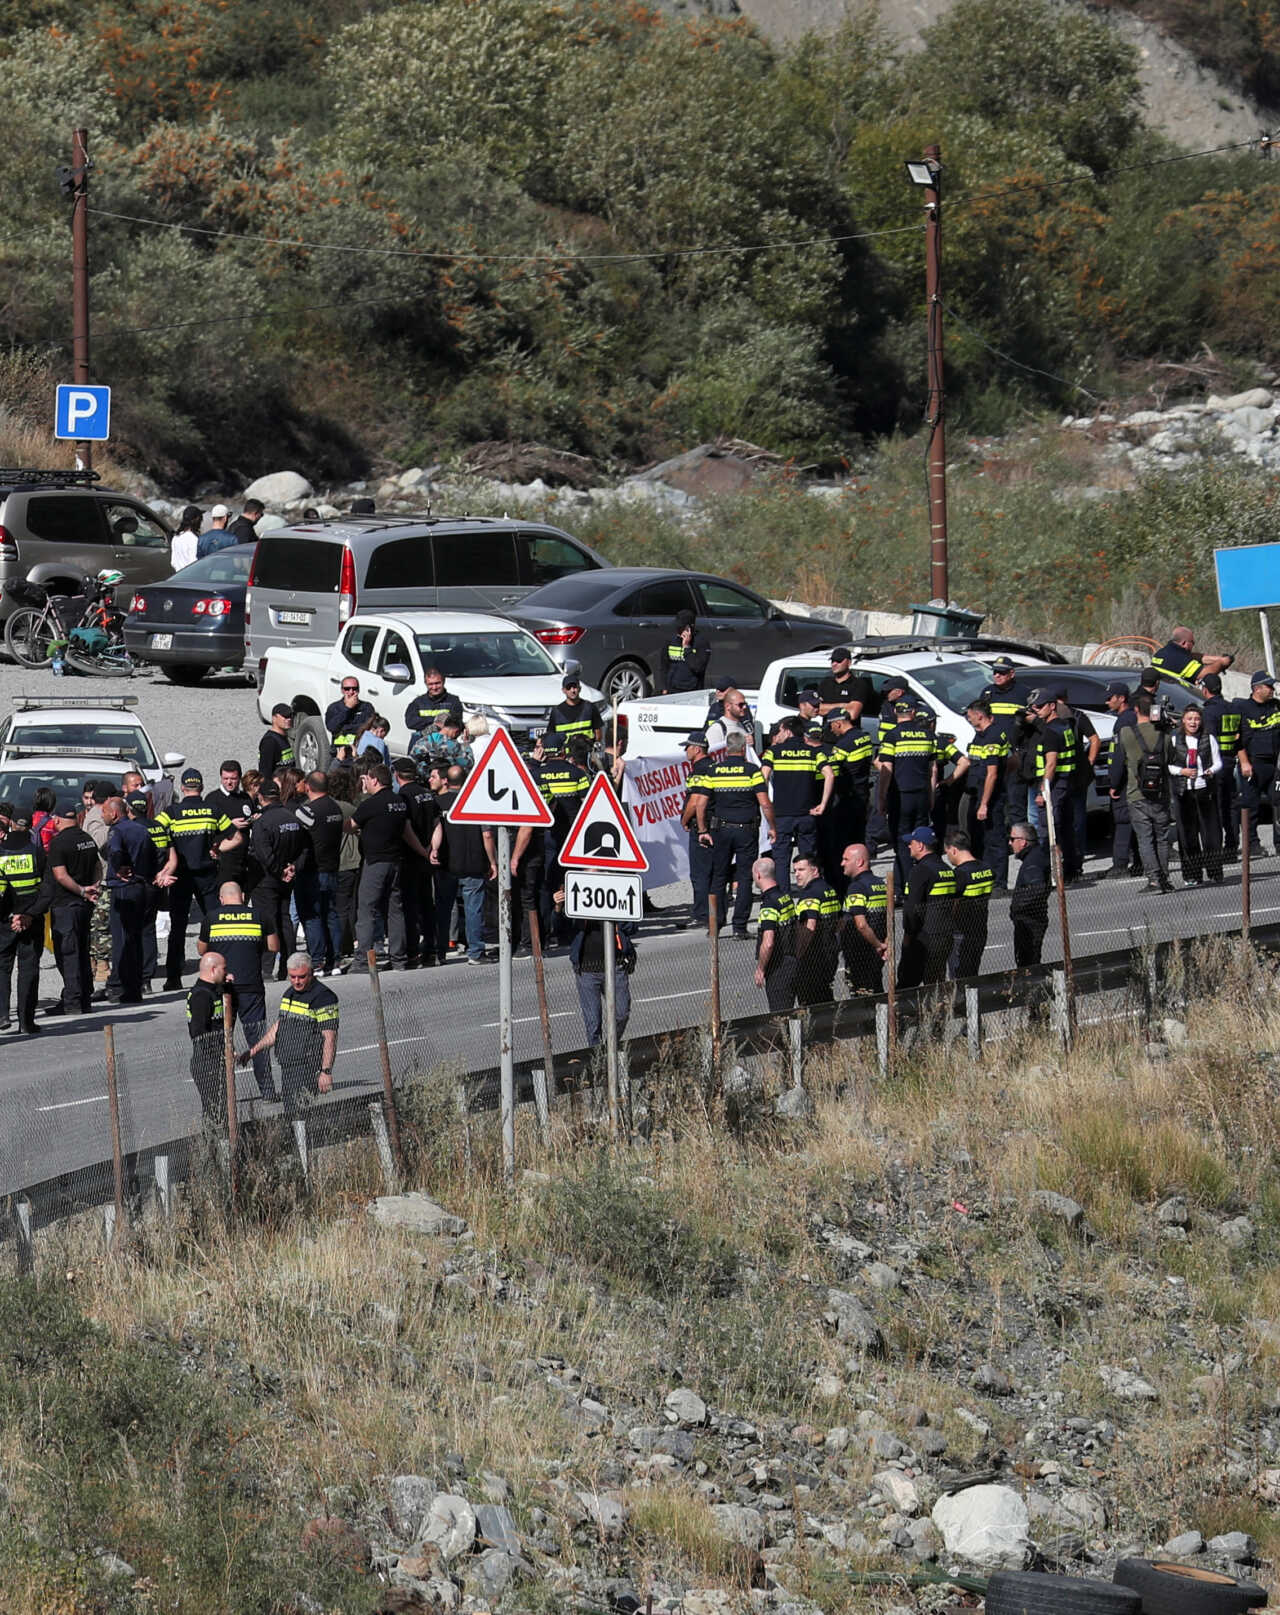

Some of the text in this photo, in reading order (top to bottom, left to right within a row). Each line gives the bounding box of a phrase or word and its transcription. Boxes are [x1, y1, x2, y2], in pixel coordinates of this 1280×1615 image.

[67, 391, 98, 433] P
[637, 713, 658, 722] 8208
[901, 730, 927, 738] POLICE
[715, 766, 744, 774] POLICE
[541, 772, 570, 780] POLICE
[634, 764, 682, 798] RUSSIAN
[182, 808, 212, 817] POLICE
[633, 793, 682, 827] YOU ARE
[971, 869, 993, 880] POLICE
[219, 913, 252, 921] POLICE
